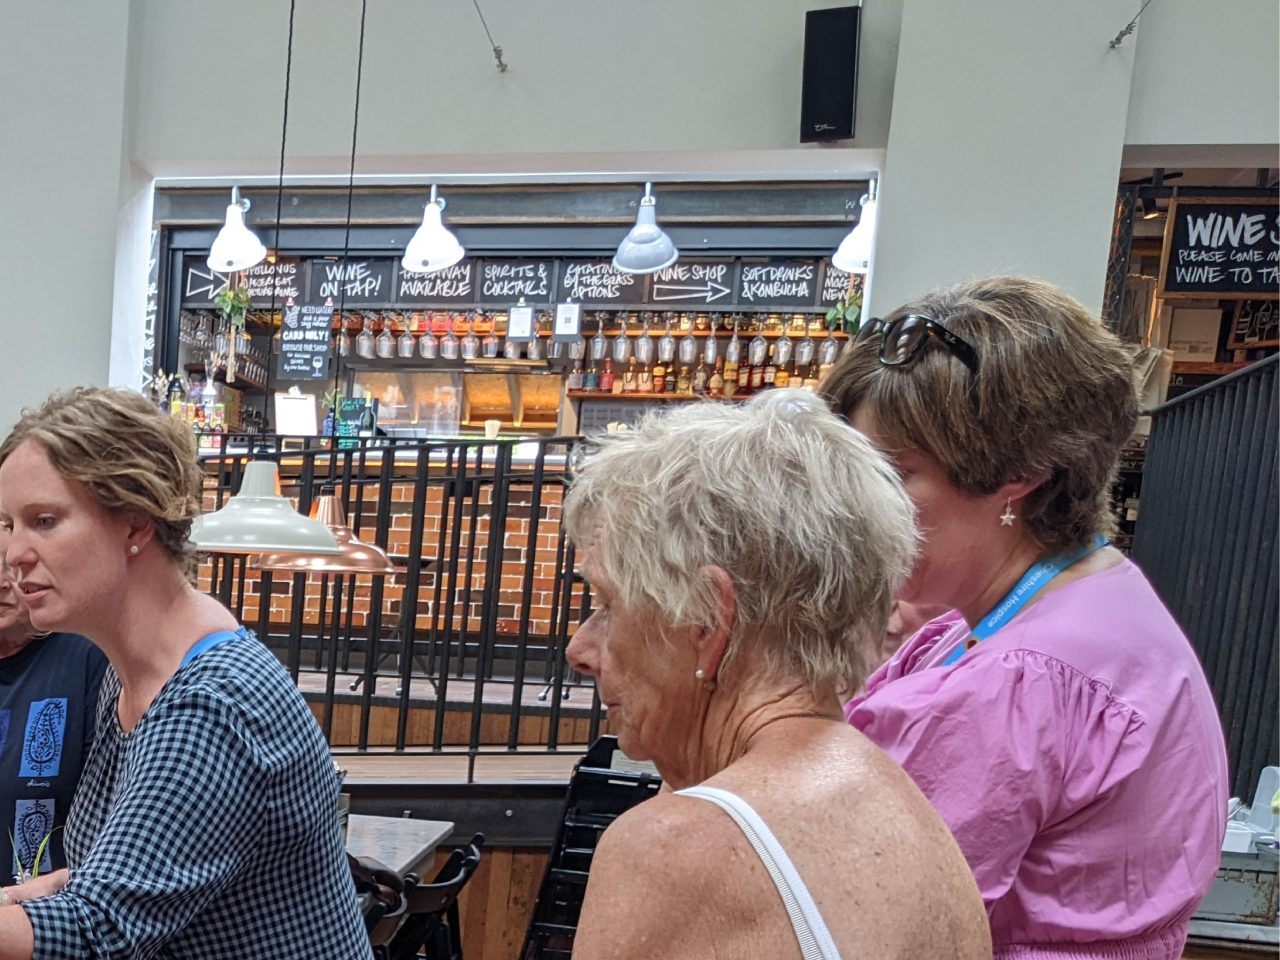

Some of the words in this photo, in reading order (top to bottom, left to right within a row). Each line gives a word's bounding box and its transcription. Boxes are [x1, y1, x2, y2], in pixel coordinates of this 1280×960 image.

[1187, 212, 1266, 248] WINE
[1179, 249, 1227, 264] PLEASE
[1230, 249, 1264, 262] COME
[326, 262, 371, 281] WINE
[484, 264, 535, 281] SPIRITS
[580, 275, 602, 286] THE
[654, 265, 690, 282] WINE
[691, 264, 727, 281] SHOP
[742, 266, 768, 281] SOFT
[770, 265, 814, 280] DRINKS
[1176, 266, 1226, 283] WINE
[1228, 267, 1253, 284] TO
[320, 281, 338, 297] ON
[345, 274, 381, 297] TAP!
[400, 279, 471, 297] AVAILABLE
[483, 280, 548, 295] COCKTAILS
[571, 284, 620, 299] OPTIONS
[283, 330, 304, 341] CARD
[1015, 563, 1054, 596] Cheshire
[987, 594, 1020, 628] Hospice
